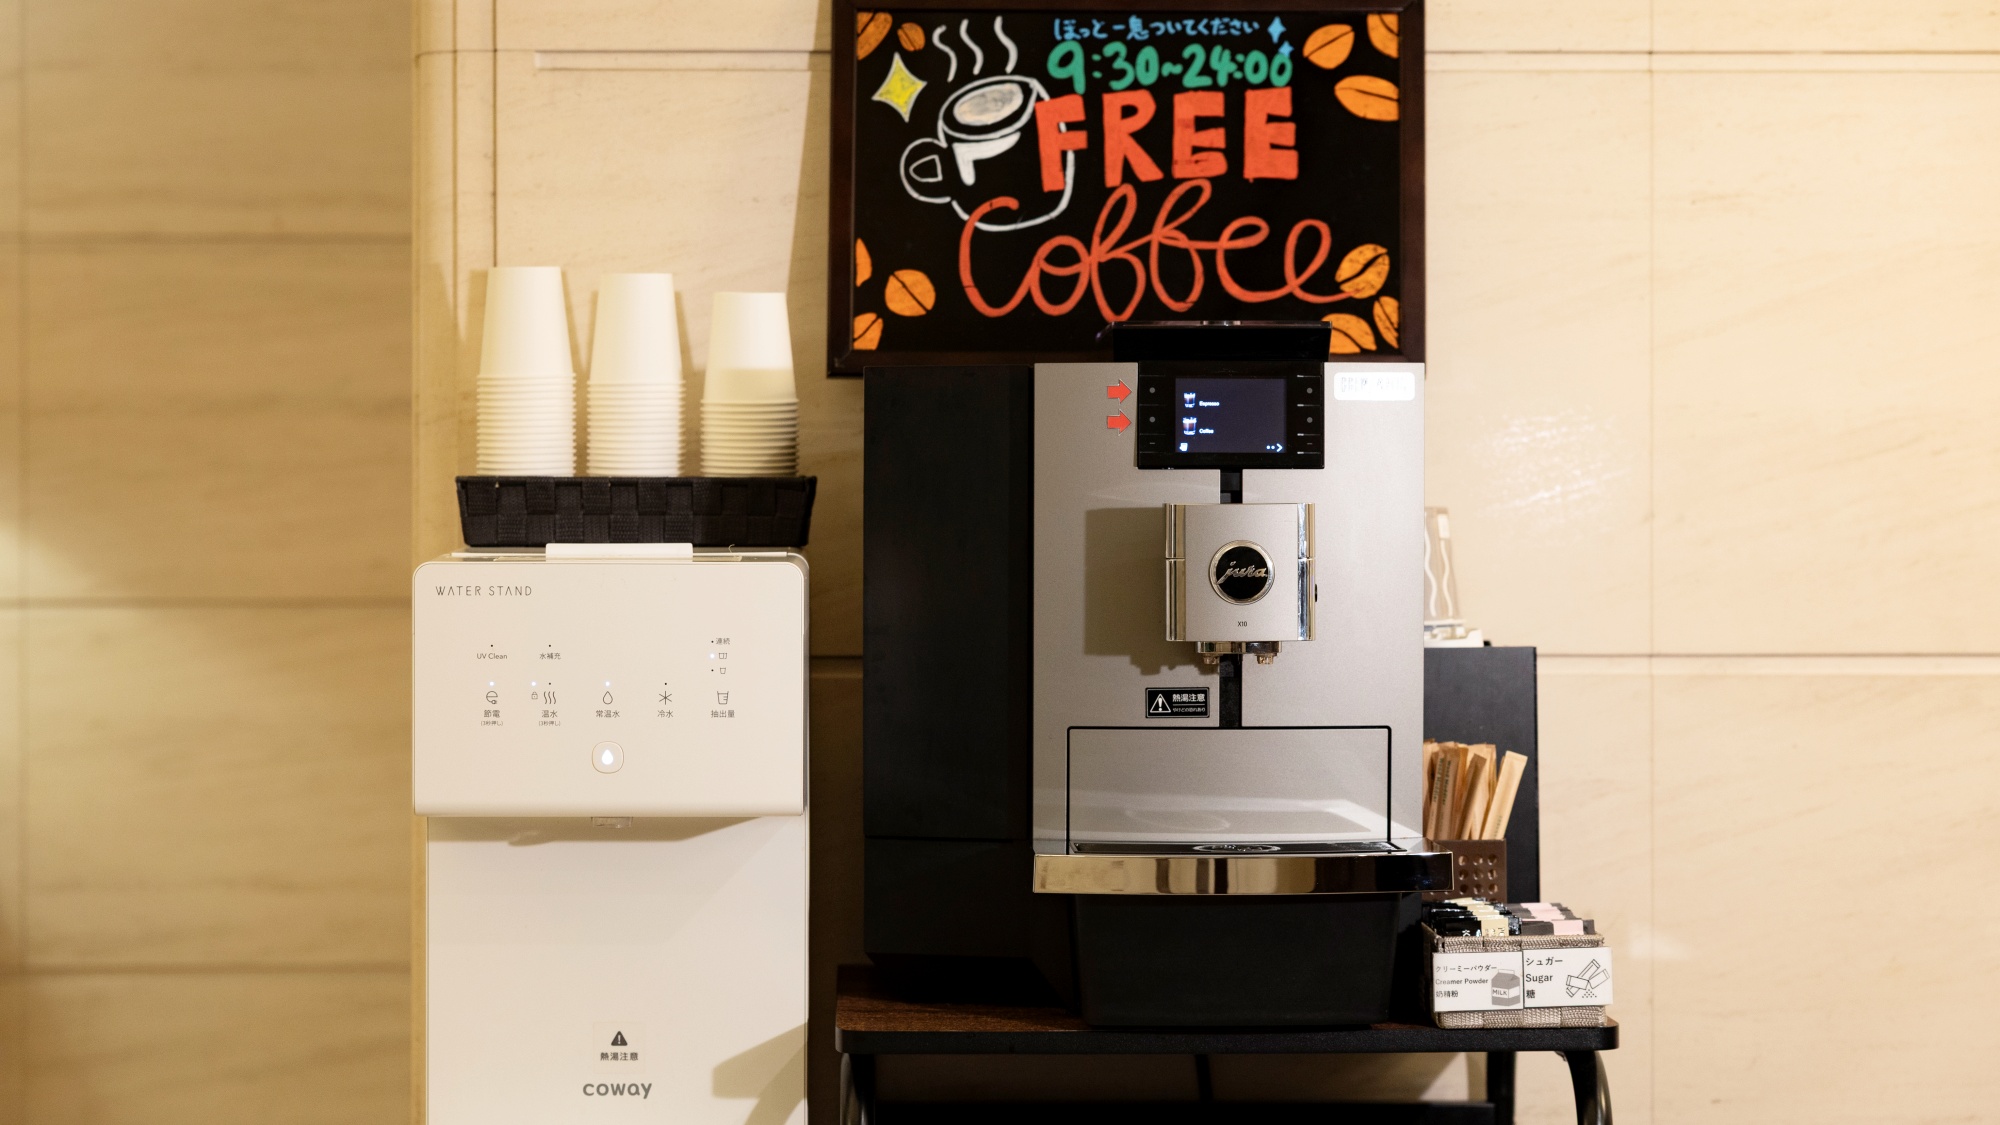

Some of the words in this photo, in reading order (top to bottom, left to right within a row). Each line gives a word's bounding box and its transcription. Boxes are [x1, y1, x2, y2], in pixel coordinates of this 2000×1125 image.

[1034, 86, 1299, 193] FREE
[958, 178, 1366, 323] Coffee
[1216, 560, 1268, 585] jura
[435, 585, 482, 597] WATER
[488, 585, 532, 597] STAND
[716, 637, 731, 645] 連続
[539, 652, 562, 660] 水補充
[1172, 693, 1206, 702] 熱湯注意
[484, 709, 500, 718] 節電
[541, 709, 558, 718] 温水
[595, 709, 620, 718] 常温水
[657, 709, 674, 718] 冷水
[710, 709, 735, 718] 抽出量
[1525, 956, 1564, 967] シュガー
[1525, 973, 1554, 984] Sugar
[1526, 989, 1536, 999] 糖
[600, 1052, 639, 1062] 熱湯注意
[582, 1082, 652, 1100] coway
